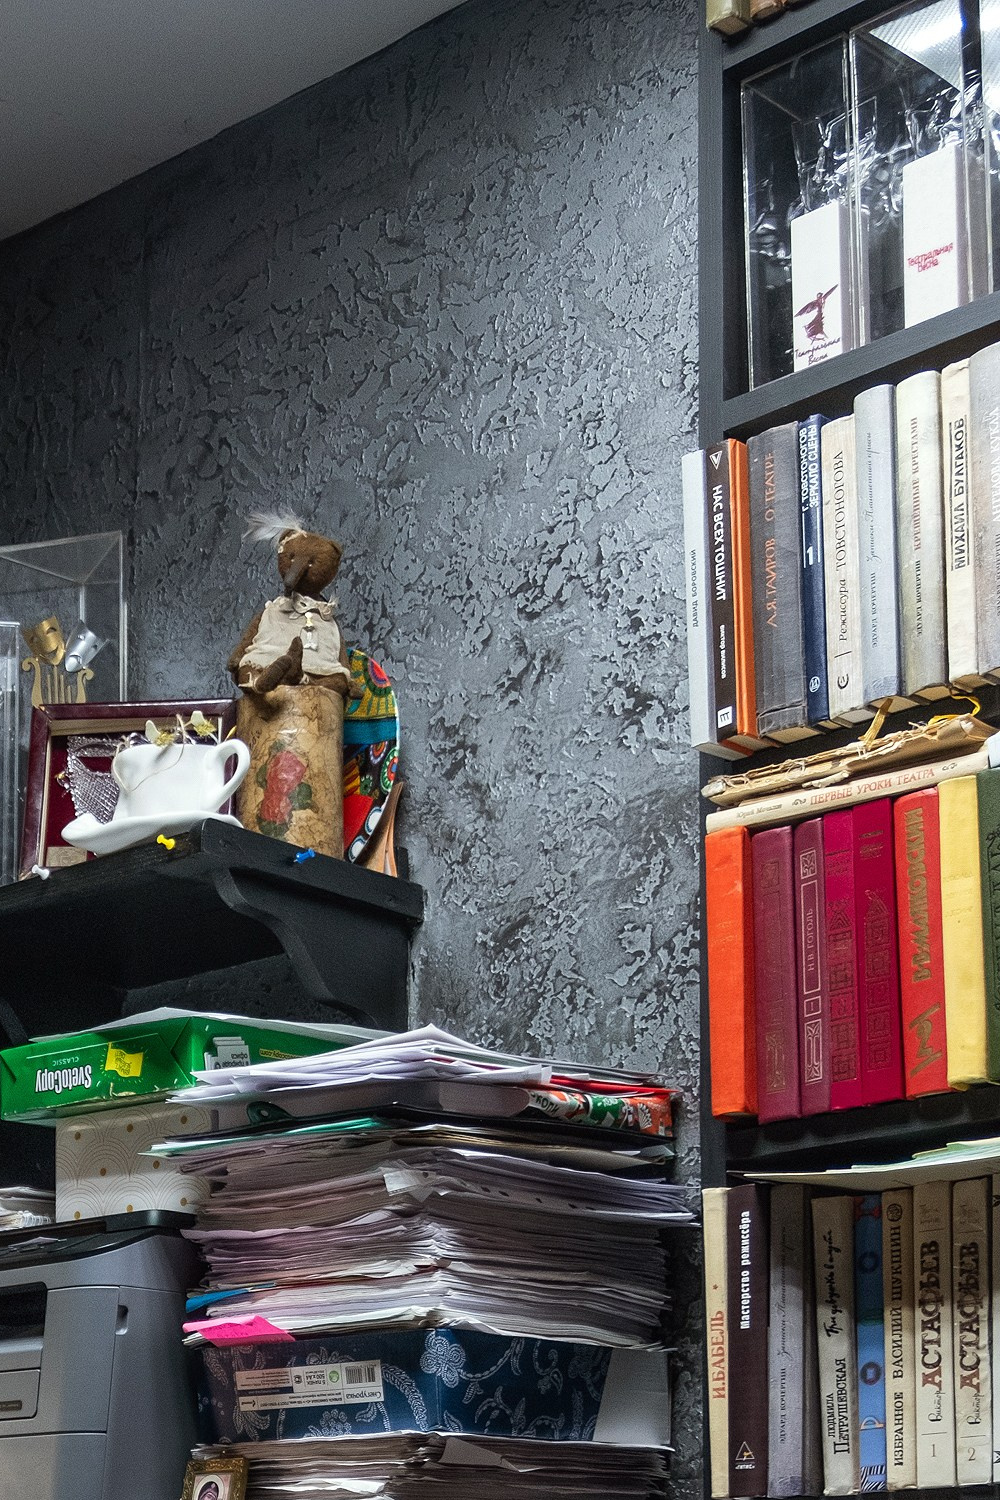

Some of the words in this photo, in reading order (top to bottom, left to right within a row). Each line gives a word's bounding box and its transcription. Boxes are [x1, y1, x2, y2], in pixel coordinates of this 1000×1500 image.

[800, 428, 808, 500] ТОВСТОНОГОВ
[808, 425, 818, 460] СЦЕНЫ
[910, 417, 920, 474] КРЕСТАМИ
[953, 417, 964, 495] БУЛГАКОВ
[712, 484, 724, 511] НАС
[764, 451, 775, 502] ТЕАТРЕ
[809, 462, 819, 508] ЗЕРКАЛО
[713, 513, 725, 548] ВСЕХ
[833, 450, 846, 571] ТОВСТОНОГОВА
[953, 502, 966, 570] МИХАИЛ
[690, 549, 698, 597] БОРОВСКИЙ
[715, 545, 727, 601] ТОШНИТ
[869, 572, 877, 615] КОЧЕРГИН
[914, 560, 922, 603] КОЧЕРГИН
[837, 579, 848, 641] Режиссура
[810, 787, 852, 805] ПЕРВЫЕ
[857, 778, 892, 794] УРОКИ
[896, 768, 935, 787] ТЕАТРА
[805, 908, 814, 948] ГОГОЛЬ
[35, 1065, 92, 1094] SvetoCopy
[52, 1056, 79, 1066] CLASSIC
[739, 1211, 751, 1265] режиссёра
[890, 1225, 903, 1301] ШУКШИН
[739, 1270, 750, 1329] Мастерство
[918, 1240, 944, 1390] АСТАФЬЕВ
[957, 1242, 983, 1393] АСТАФЬЕВ
[710, 1310, 726, 1400] И.БАБЕЛЬ
[890, 1307, 904, 1379] ВАСИЛИЙ
[346, 1391, 381, 1399] Снегурочка
[826, 1393, 836, 1438] ЛЮДМИЛА
[833, 1358, 850, 1454] ПЕТРУШЕВСКАЯ
[893, 1392, 904, 1466] ИЗБРАННОЕ
[967, 1447, 976, 1461] 2
